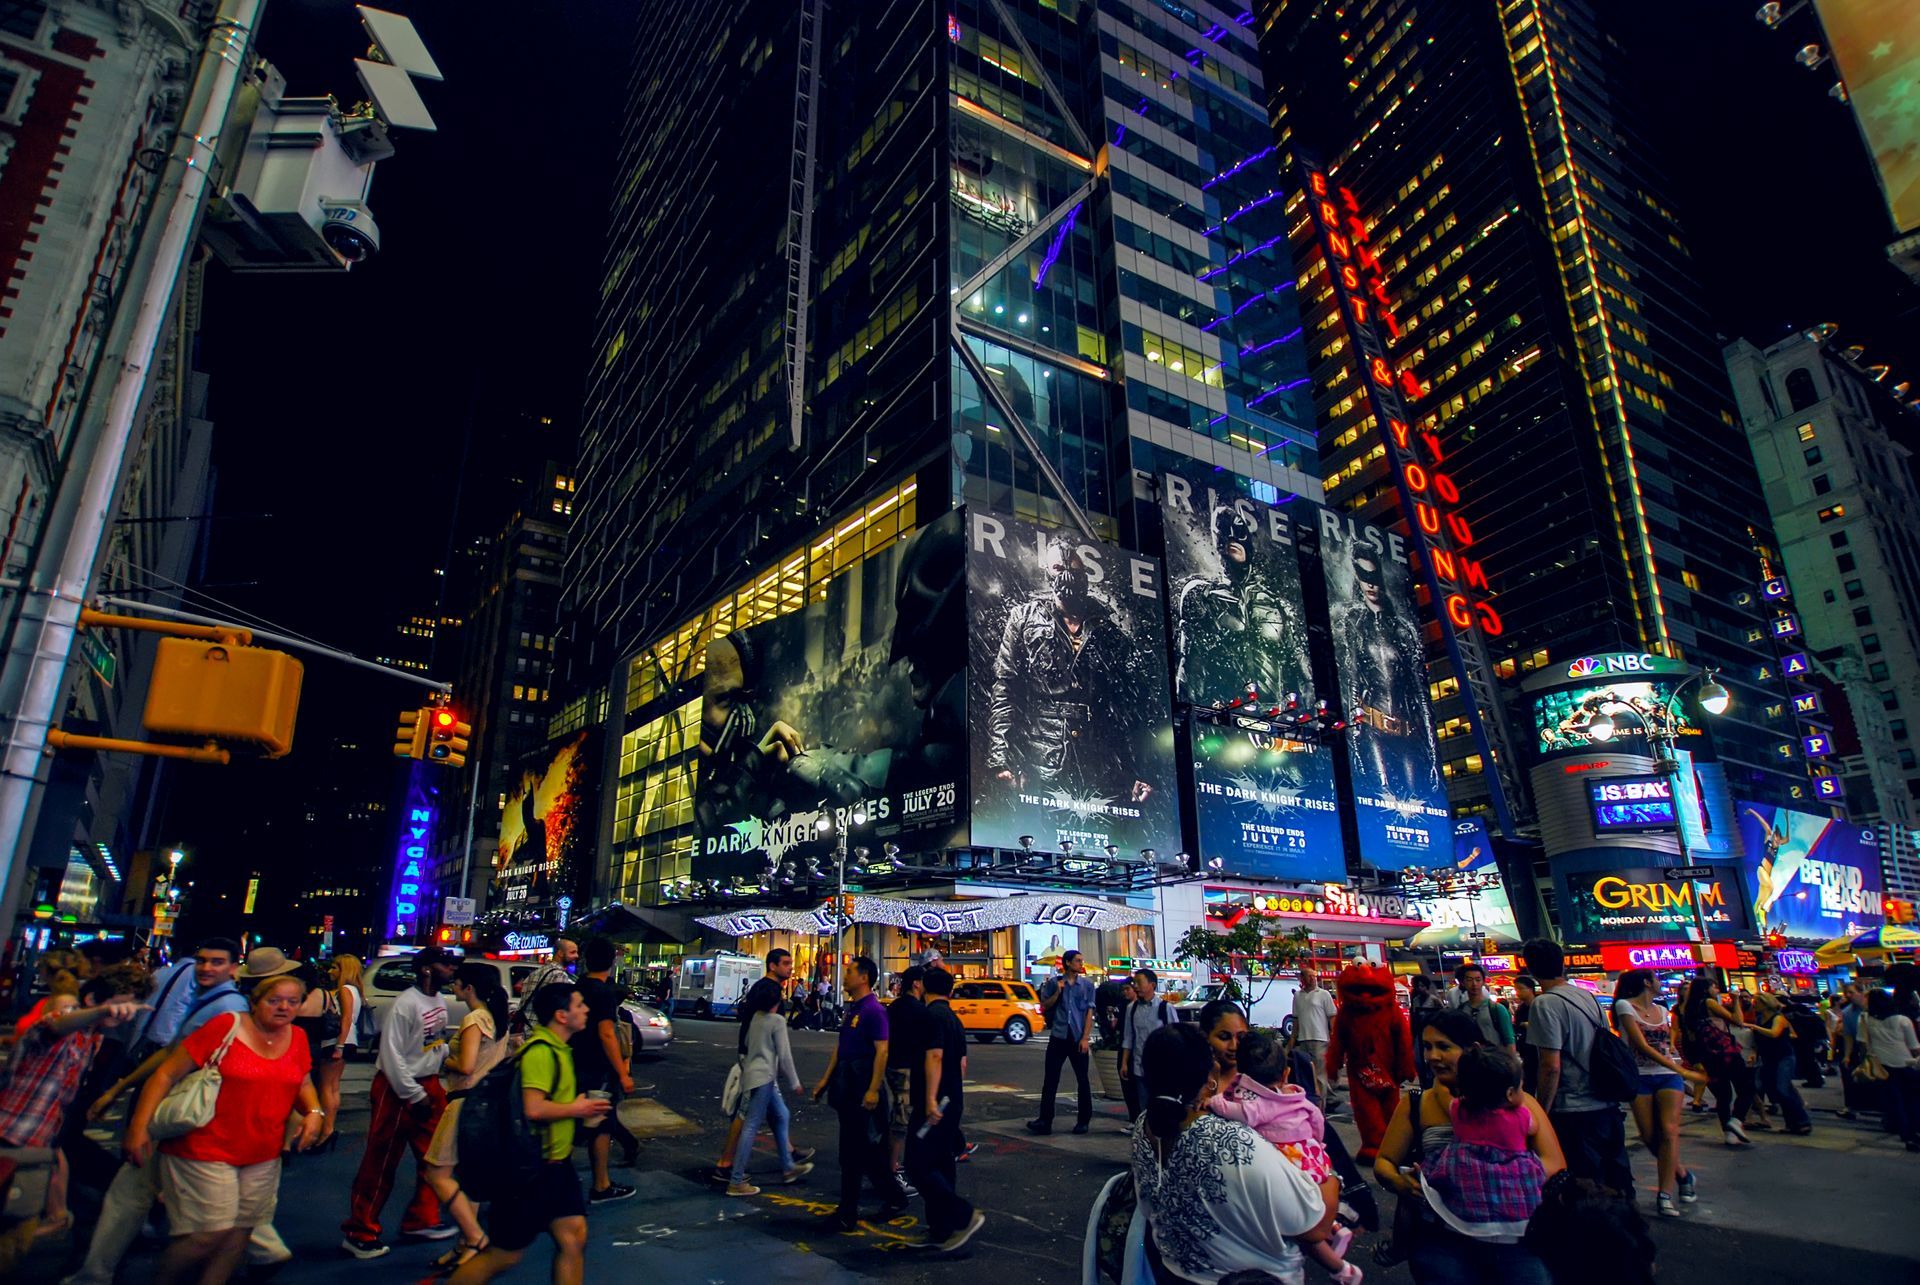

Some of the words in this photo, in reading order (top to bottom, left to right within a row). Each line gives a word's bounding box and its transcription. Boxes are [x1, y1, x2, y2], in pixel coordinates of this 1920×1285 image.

[1311, 172, 1367, 325] ERNST
[1371, 357, 1393, 387] &
[1390, 418, 1472, 628] YOUNG
[1166, 472, 1292, 546] RISE
[1319, 508, 1408, 564] RISE
[973, 512, 1157, 599] RISE
[1606, 653, 1655, 673] NBC
[1765, 581, 1836, 794] CHAMPS
[1633, 727, 1642, 735] IS
[1564, 761, 1609, 774] SHARP
[902, 793, 933, 815] JULY
[936, 789, 956, 808] 20
[903, 791, 914, 800] THE
[915, 786, 937, 798] LEGEND
[938, 782, 955, 792] ENDS
[1198, 781, 1223, 795] THE
[1226, 785, 1257, 800] DARK
[1261, 790, 1301, 807] KNIGHT
[1304, 797, 1336, 812] RISES
[1019, 793, 1039, 805] THE
[1042, 797, 1070, 808] DARK
[1073, 800, 1110, 813] KNIGHT
[1112, 806, 1140, 817] RISES
[1357, 796, 1373, 806] THE
[1374, 799, 1396, 809] DARK
[1397, 802, 1424, 814] KNIGHT
[1426, 807, 1448, 817] RISES
[706, 832, 752, 855] DARK
[761, 822, 822, 846] KNIGH
[835, 796, 890, 829] RIES
[1069, 830, 1092, 839] LEGEND
[1240, 822, 1256, 832] THE
[1257, 824, 1285, 835] LEGEND
[1286, 828, 1305, 838] ENDS
[1094, 838, 1109, 847] 20
[1242, 832, 1279, 845] JULY
[1289, 836, 1306, 848] 20
[1387, 831, 1411, 841] JULY
[1417, 835, 1429, 844] 20
[497, 869, 512, 879] DARK
[513, 864, 537, 876] KNIGHT
[539, 861, 559, 872] RISES
[1799, 858, 1862, 891] BEYOND
[506, 891, 519, 902] JULY
[519, 889, 527, 899] 20
[1325, 885, 1408, 919] Subway
[1592, 876, 1727, 912] GRIMM
[1820, 884, 1882, 915] REASON
[728, 914, 772, 934] LOFT
[901, 908, 984, 933] LOFT
[1037, 903, 1108, 926] LOFT
[1600, 916, 1646, 925] MONDAY
[1647, 915, 1672, 924] AUG
[1672, 914, 1684, 923] 13
[1629, 948, 1693, 965] CHAM
